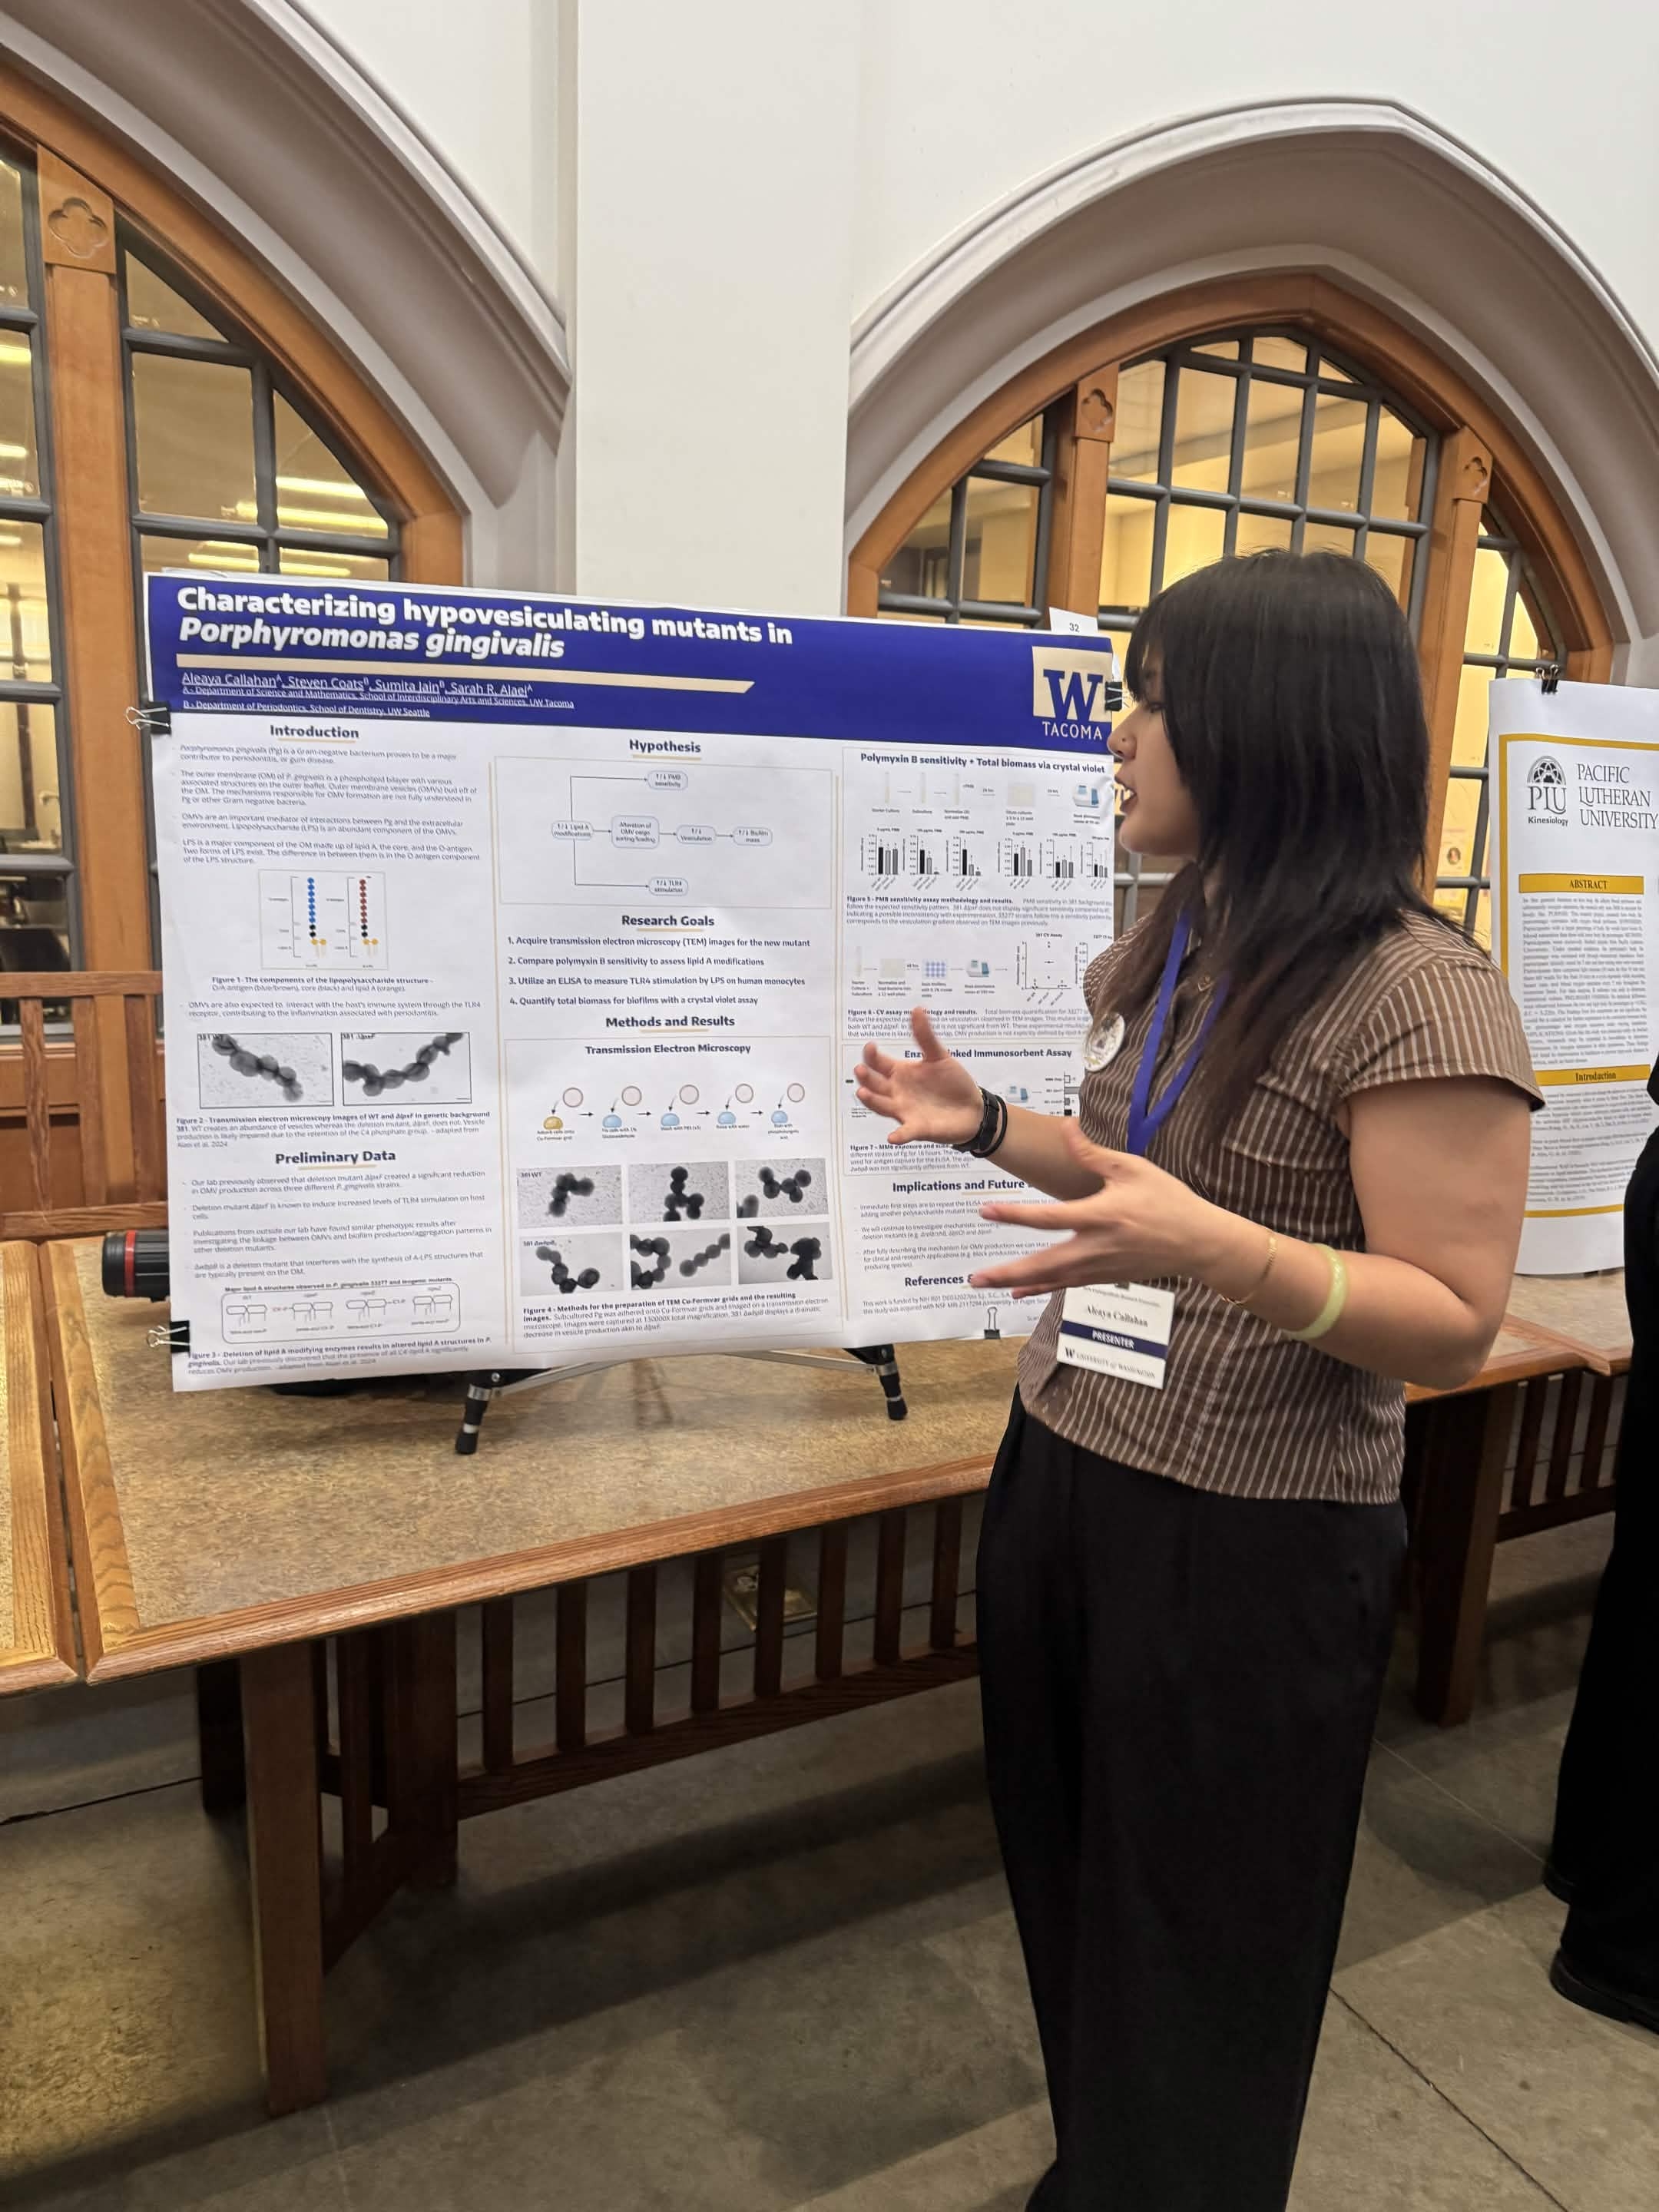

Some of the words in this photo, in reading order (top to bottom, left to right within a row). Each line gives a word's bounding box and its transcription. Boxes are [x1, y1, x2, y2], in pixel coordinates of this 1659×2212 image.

[177, 588, 395, 625] Characterizing
[403, 599, 644, 639] hypovesiculating
[652, 618, 761, 642] mutants
[767, 622, 792, 644] in
[1069, 623, 1080, 633] 32
[179, 616, 418, 651] Porphyromonas
[425, 627, 564, 659] gingivalis
[287, 676, 329, 689] Steven
[375, 679, 416, 692] Sumita
[451, 681, 482, 694] Sarah
[1043, 668, 1103, 722] W
[270, 724, 359, 738] Introduction
[1042, 721, 1102, 740] TACOMA
[629, 739, 701, 753] Hypothesis
[860, 752, 909, 765] Polymyxin
[911, 755, 917, 763] B
[920, 756, 967, 768] sensitivity
[975, 758, 998, 767] Total
[1001, 759, 1036, 770] biomass
[1038, 761, 1051, 770] via
[1052, 763, 1080, 773] crystal
[1081, 763, 1104, 773] violet
[1578, 763, 1630, 783] PACIFIC
[1528, 786, 1567, 814] PLU
[1578, 786, 1651, 807] LUTHERAN
[1528, 816, 1568, 826] Kinesiology
[1580, 809, 1659, 830] UNIVERSITY
[1570, 879, 1608, 889] ABSTRACT
[621, 915, 676, 926] Research
[680, 916, 714, 926] Goals
[507, 936, 515, 945] 1.
[516, 936, 548, 946] Acquire
[550, 936, 601, 945] transmission
[602, 937, 634, 945] electron
[636, 937, 680, 948] microscopy
[682, 938, 707, 948] (TEM)
[708, 938, 736, 948] images
[737, 938, 747, 946] for
[750, 938, 762, 946] the
[508, 956, 516, 965] 2.
[518, 956, 553, 967] Compare
[555, 956, 598, 967] polymyxin
[607, 957, 647, 967] sensitivity
[650, 957, 657, 965] to
[687, 957, 704, 968] lipid
[508, 976, 516, 985] 3.
[518, 976, 544, 985] Utilize
[558, 976, 582, 985] ELISA
[584, 976, 591, 985] to
[630, 976, 651, 985] TLR4
[699, 977, 708, 986] by
[763, 977, 805, 987] monocytes
[519, 997, 555, 1007] Quantify
[557, 996, 576, 1005] total
[578, 996, 611, 1005] biomass
[613, 996, 625, 1005] for
[627, 996, 659, 1005] biofilms
[687, 995, 713, 1005] crystal
[714, 995, 737, 1004] violet
[605, 1016, 661, 1027] Methods
[664, 1016, 688, 1027] and
[691, 1016, 736, 1026] Results
[585, 1045, 651, 1054] Transmission
[653, 1044, 695, 1053] Electron
[697, 1044, 751, 1054] Microscopy
[974, 1048, 1043, 1057] Immunosorbent
[1046, 1048, 1072, 1058] Assay
[1575, 1071, 1616, 1081] Introduction
[275, 1152, 358, 1164] Preliminary
[363, 1151, 396, 1162] Data
[892, 1180, 962, 1193] Implications
[963, 1179, 985, 1190] and
[988, 1179, 1025, 1189] Future
[905, 1276, 964, 1286] References
[1091, 1329, 1135, 1349] PRESENTER
